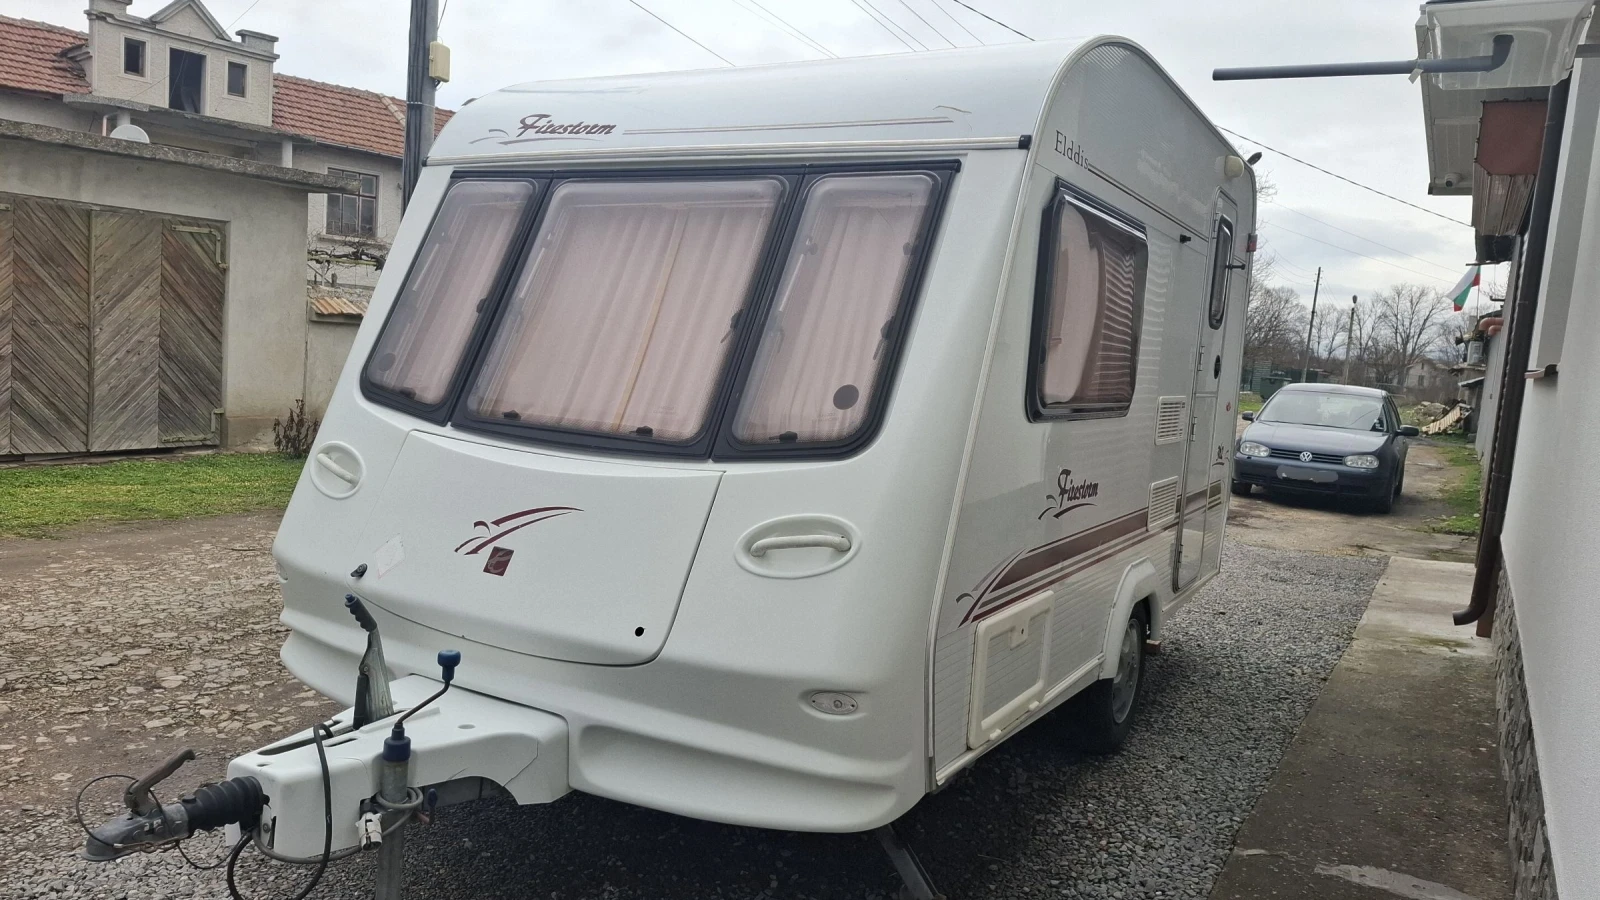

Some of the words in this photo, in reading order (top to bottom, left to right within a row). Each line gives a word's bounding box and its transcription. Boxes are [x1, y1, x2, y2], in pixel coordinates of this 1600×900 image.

[516, 113, 617, 138] Firestorm
[1054, 129, 1089, 169] Elddis
[1057, 468, 1099, 509] Firestorm
